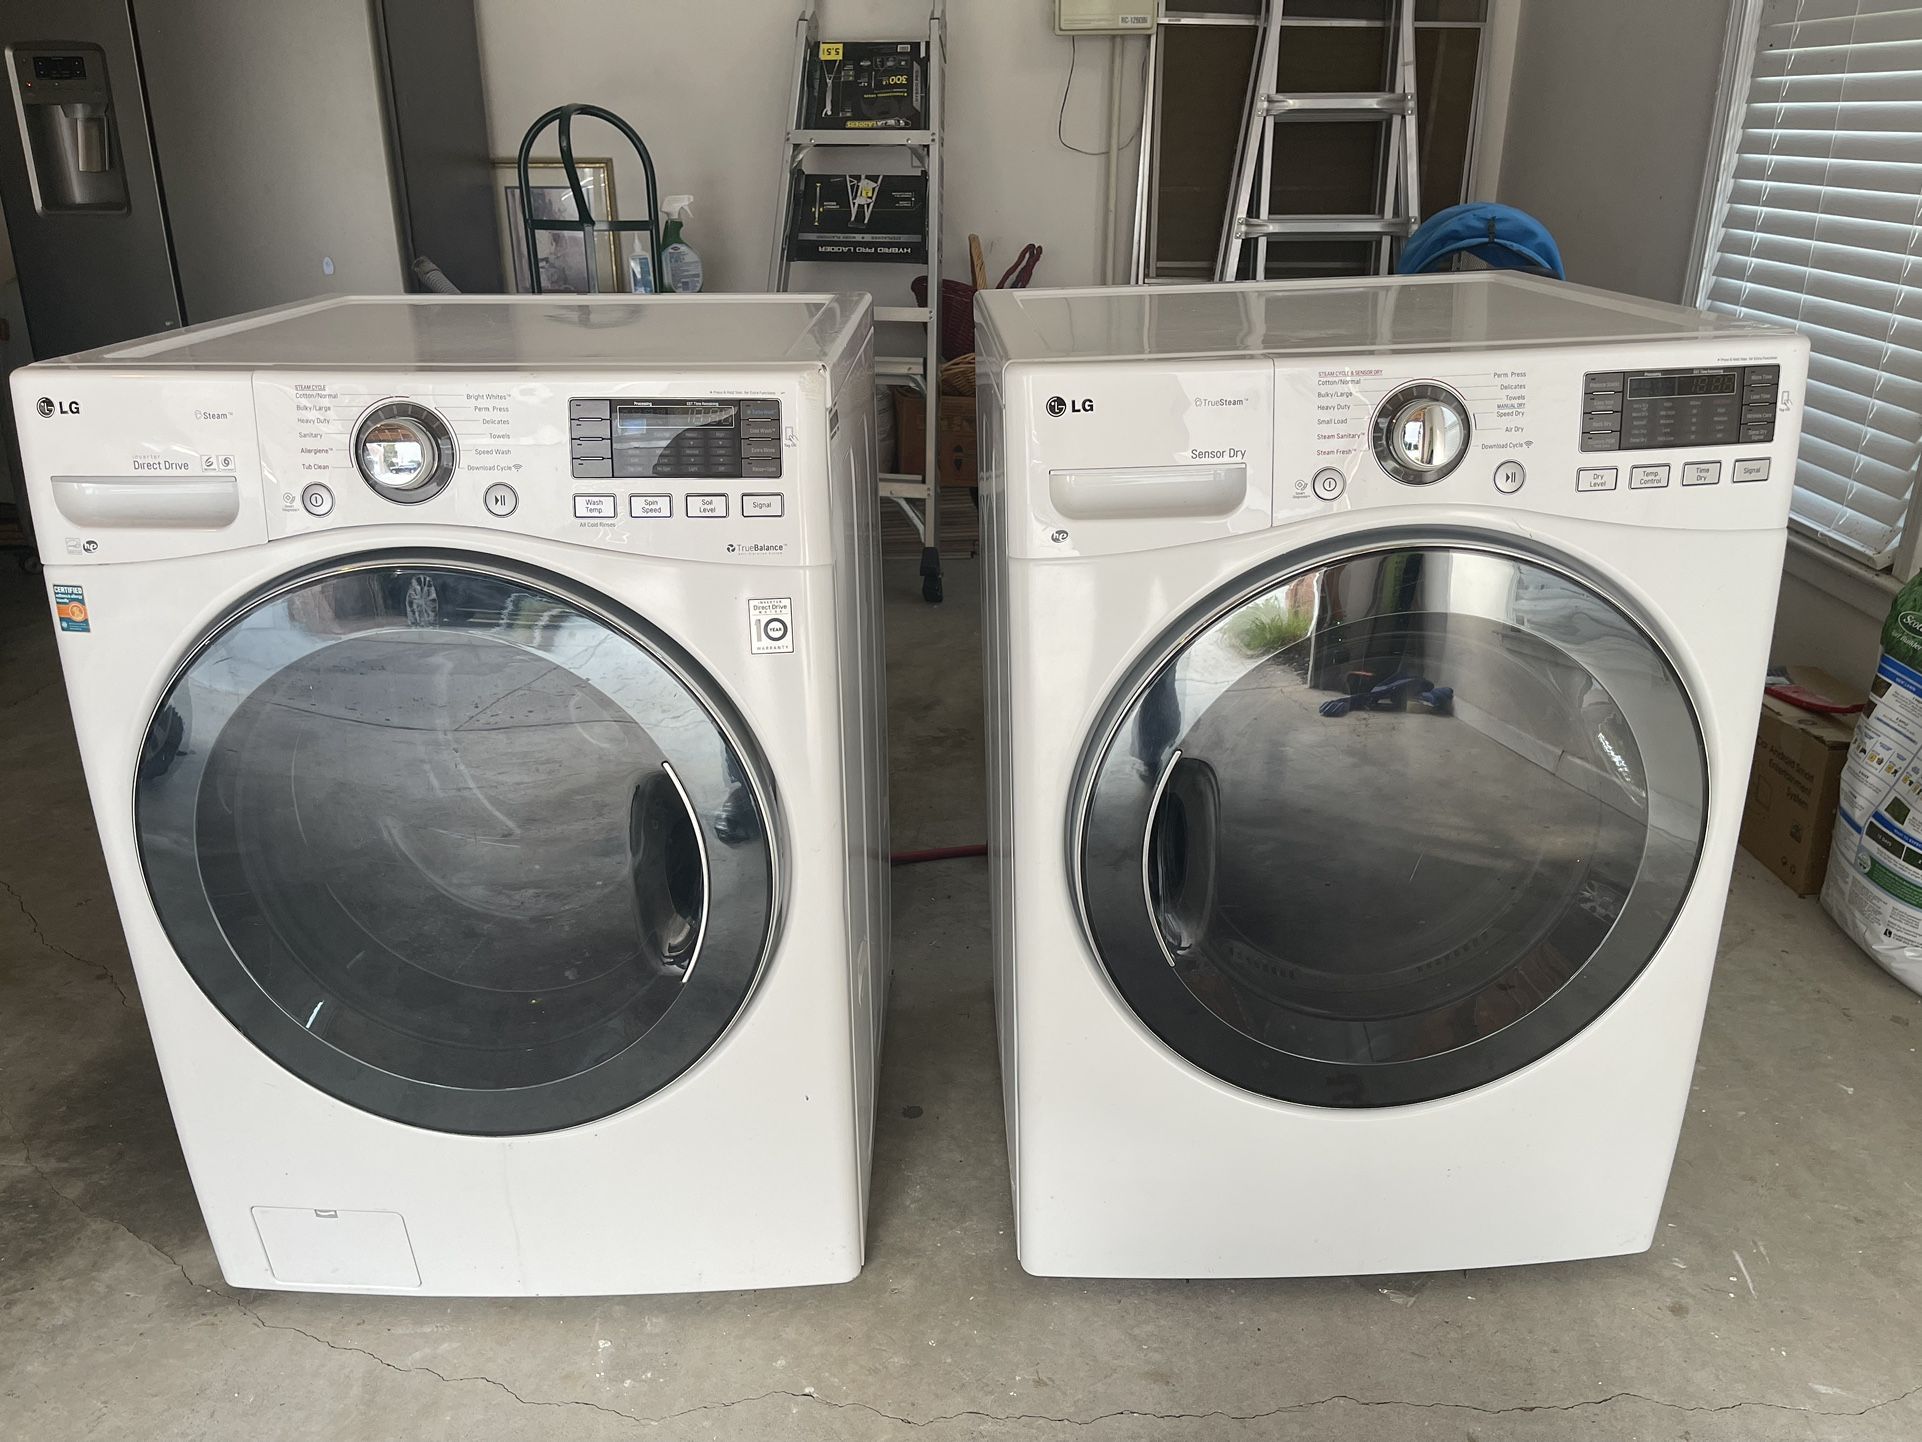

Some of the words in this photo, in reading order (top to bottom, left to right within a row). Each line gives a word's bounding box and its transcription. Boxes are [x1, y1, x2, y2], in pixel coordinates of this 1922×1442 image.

[889, 75, 908, 84] 300
[59, 401, 80, 414] LG
[1072, 398, 1094, 412] LG
[1191, 449, 1226, 459] Sensor
[1229, 448, 1246, 460] Dry
[133, 460, 162, 470] Direct
[164, 460, 189, 470] Drive
[1743, 466, 1761, 474] Signal
[1593, 473, 1604, 481] Dry
[644, 499, 658, 507] Spin
[753, 501, 772, 509] Signal
[54, 586, 82, 594] CERTIFIED
